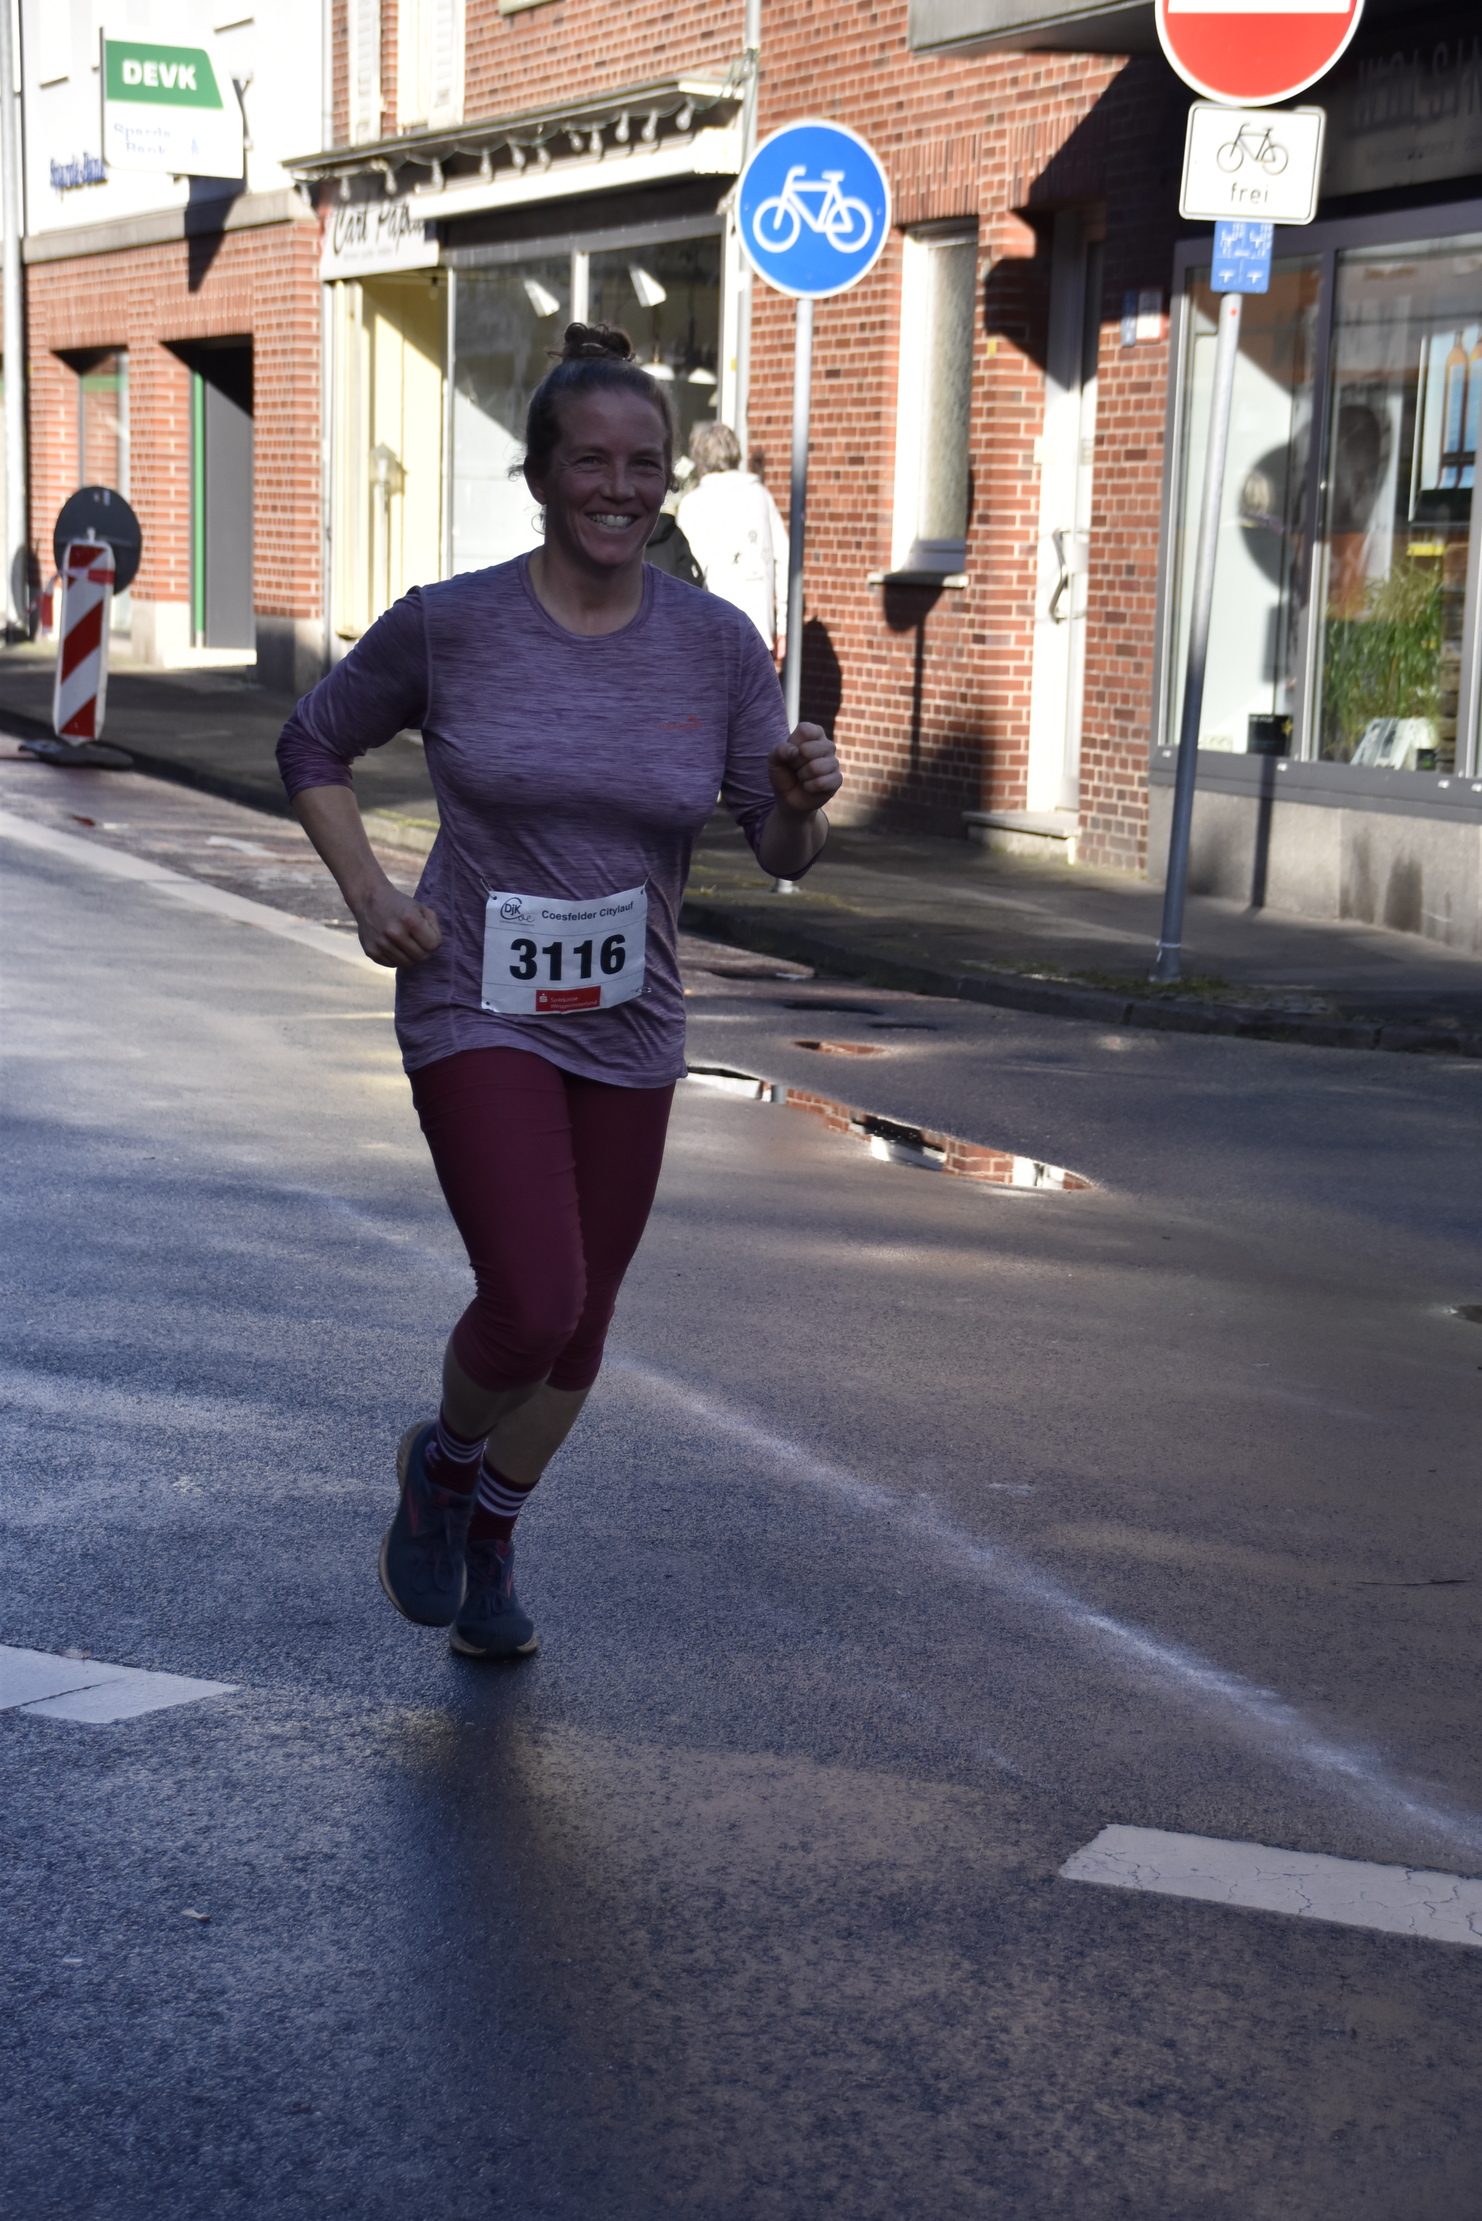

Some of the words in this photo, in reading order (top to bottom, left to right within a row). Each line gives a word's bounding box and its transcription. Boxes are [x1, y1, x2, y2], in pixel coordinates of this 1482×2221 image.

[122, 59, 198, 91] DEVK
[1230, 182, 1269, 204] frei
[541, 909, 597, 921] Coesfelder
[599, 901, 634, 917] Citylauf
[509, 934, 626, 981] 3116
